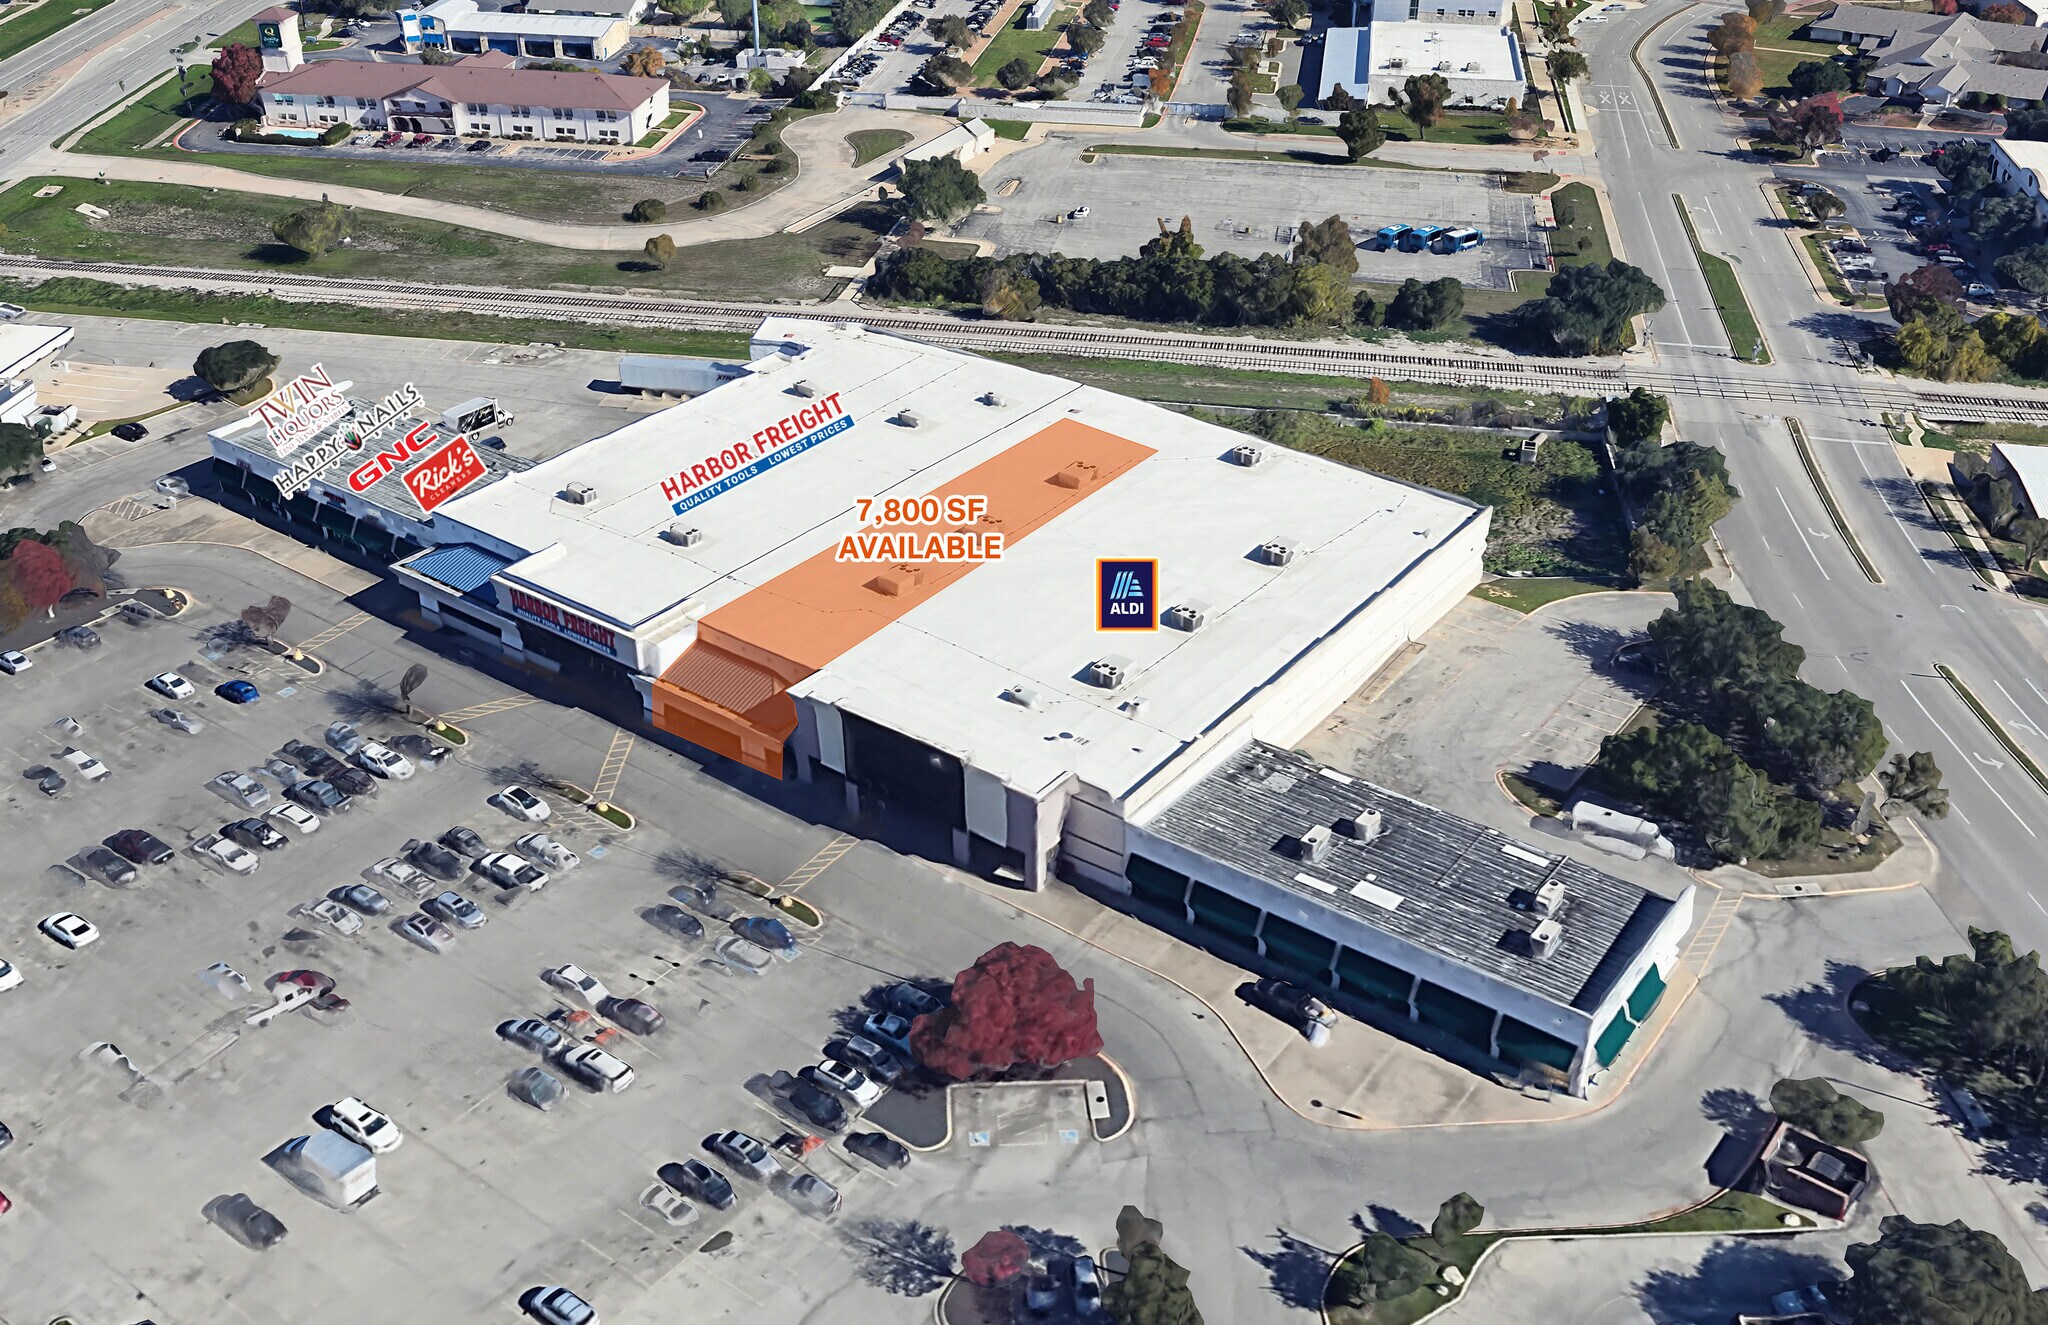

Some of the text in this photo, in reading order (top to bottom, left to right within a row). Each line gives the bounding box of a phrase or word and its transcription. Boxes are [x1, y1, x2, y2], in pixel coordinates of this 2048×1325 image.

[509, 588, 615, 649] HARBOR FREIGHT
[517, 608, 541, 623] QUALITY
[541, 618, 560, 631] TOOLS
[564, 628, 588, 644] LOWEST
